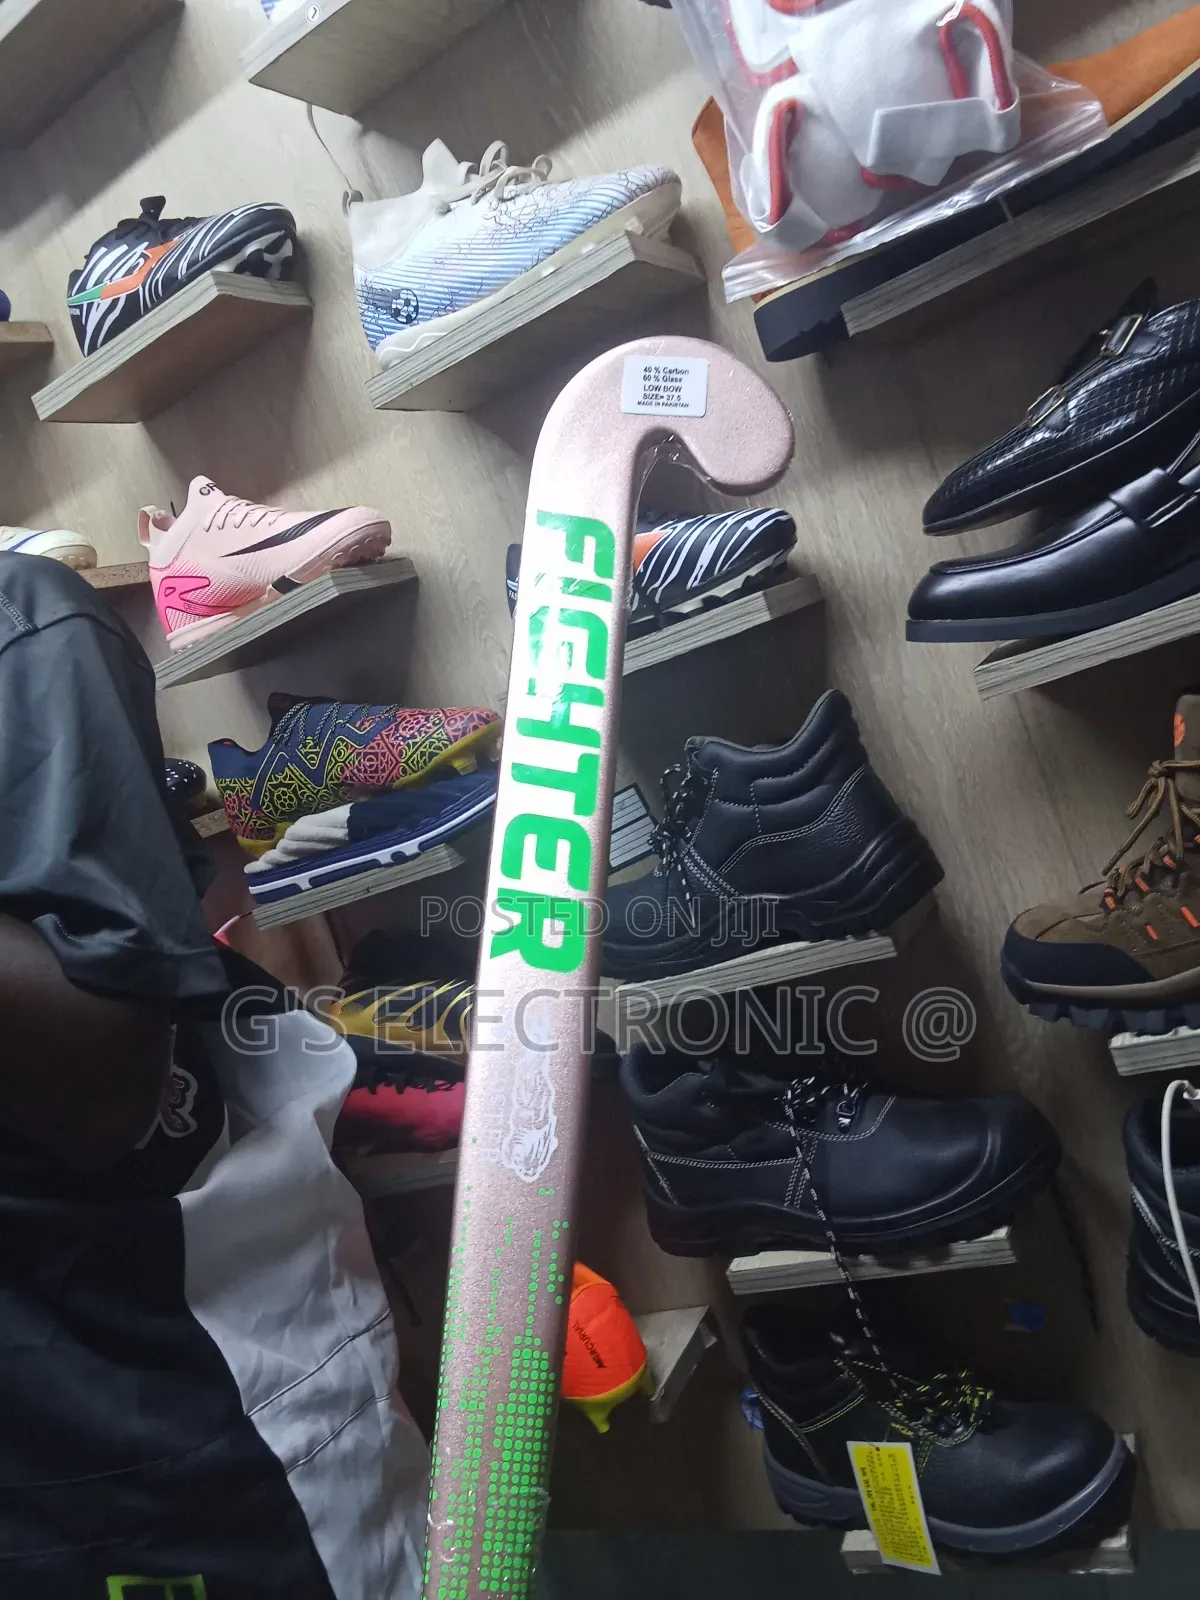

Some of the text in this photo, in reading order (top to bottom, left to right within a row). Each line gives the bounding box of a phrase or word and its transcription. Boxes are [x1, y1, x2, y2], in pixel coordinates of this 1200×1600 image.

[643, 366, 690, 375] 40 % Carbon
[643, 374, 652, 382] 60
[643, 384, 683, 393] LOW BOW
[490, 509, 616, 973] FIGHTER
